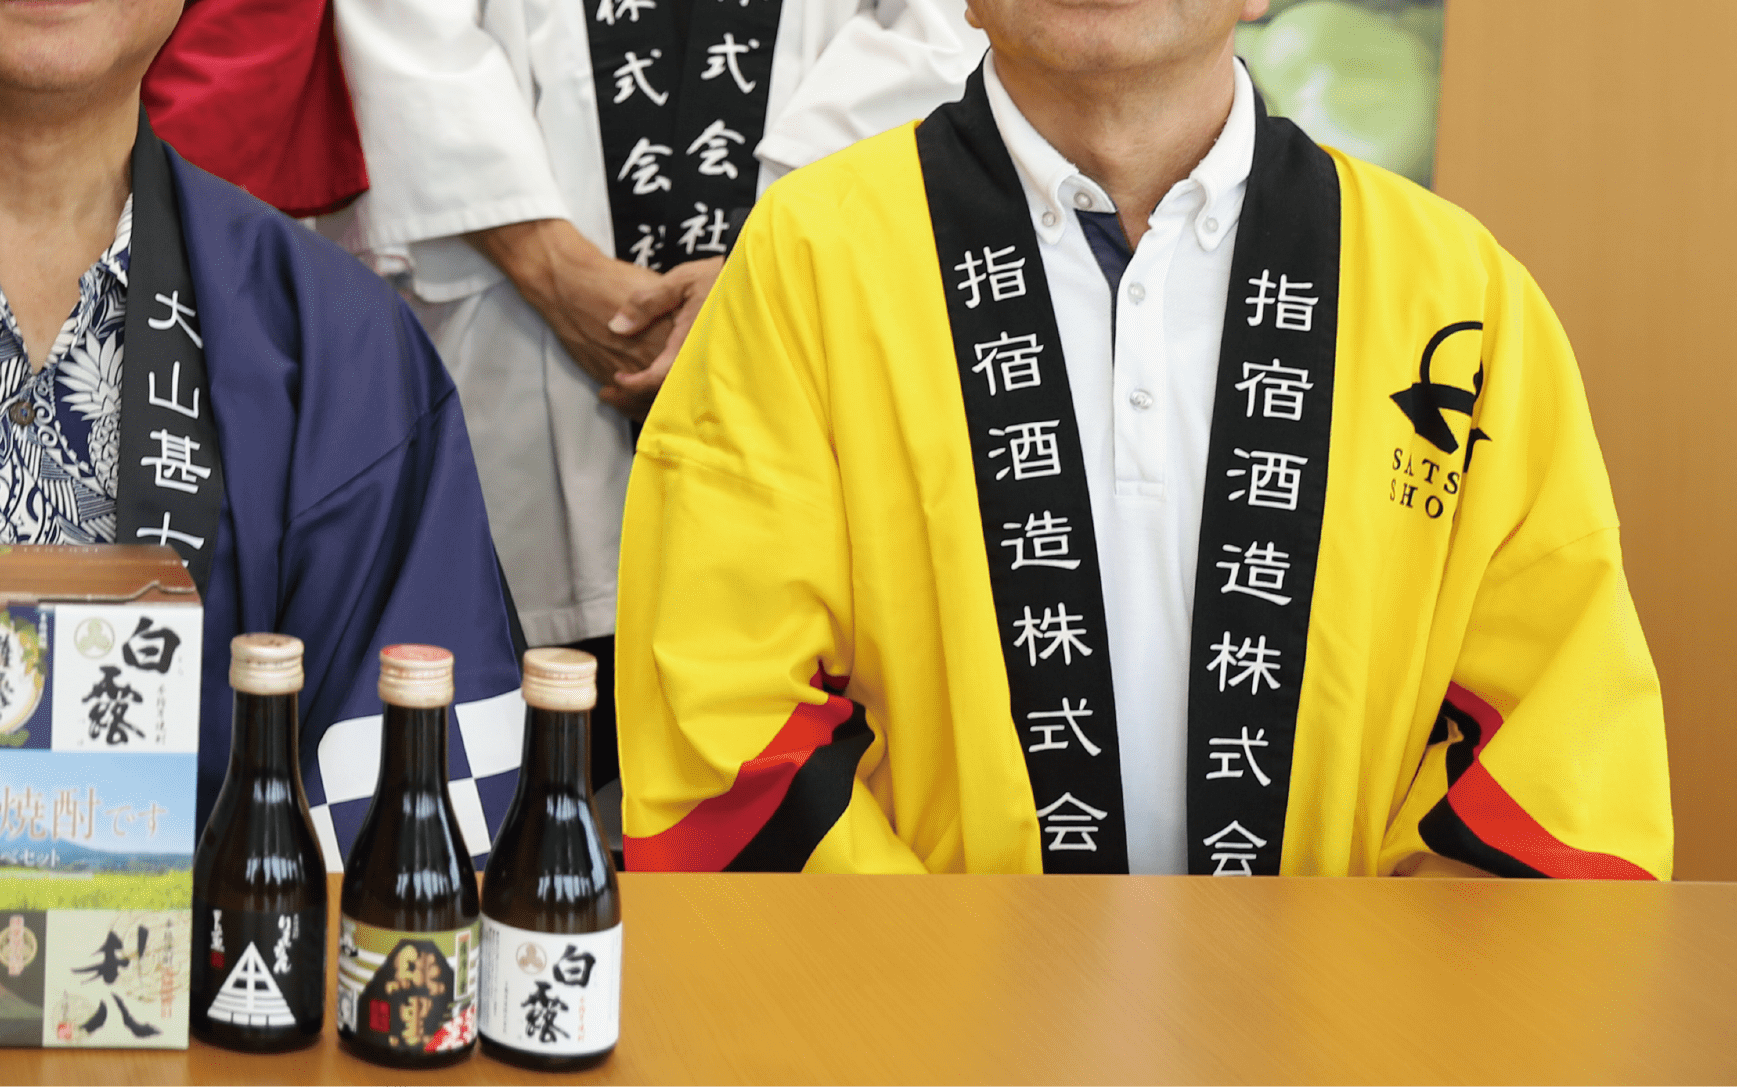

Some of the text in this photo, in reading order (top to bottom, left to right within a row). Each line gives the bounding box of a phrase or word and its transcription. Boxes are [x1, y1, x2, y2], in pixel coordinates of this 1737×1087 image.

[954, 245, 1108, 852] 指宿酒造株式会
[1202, 269, 1319, 876] 指宿酒造株式会
[80, 616, 182, 745] 白露
[70, 923, 164, 1039] 利八
[520, 942, 597, 1044] 白露
